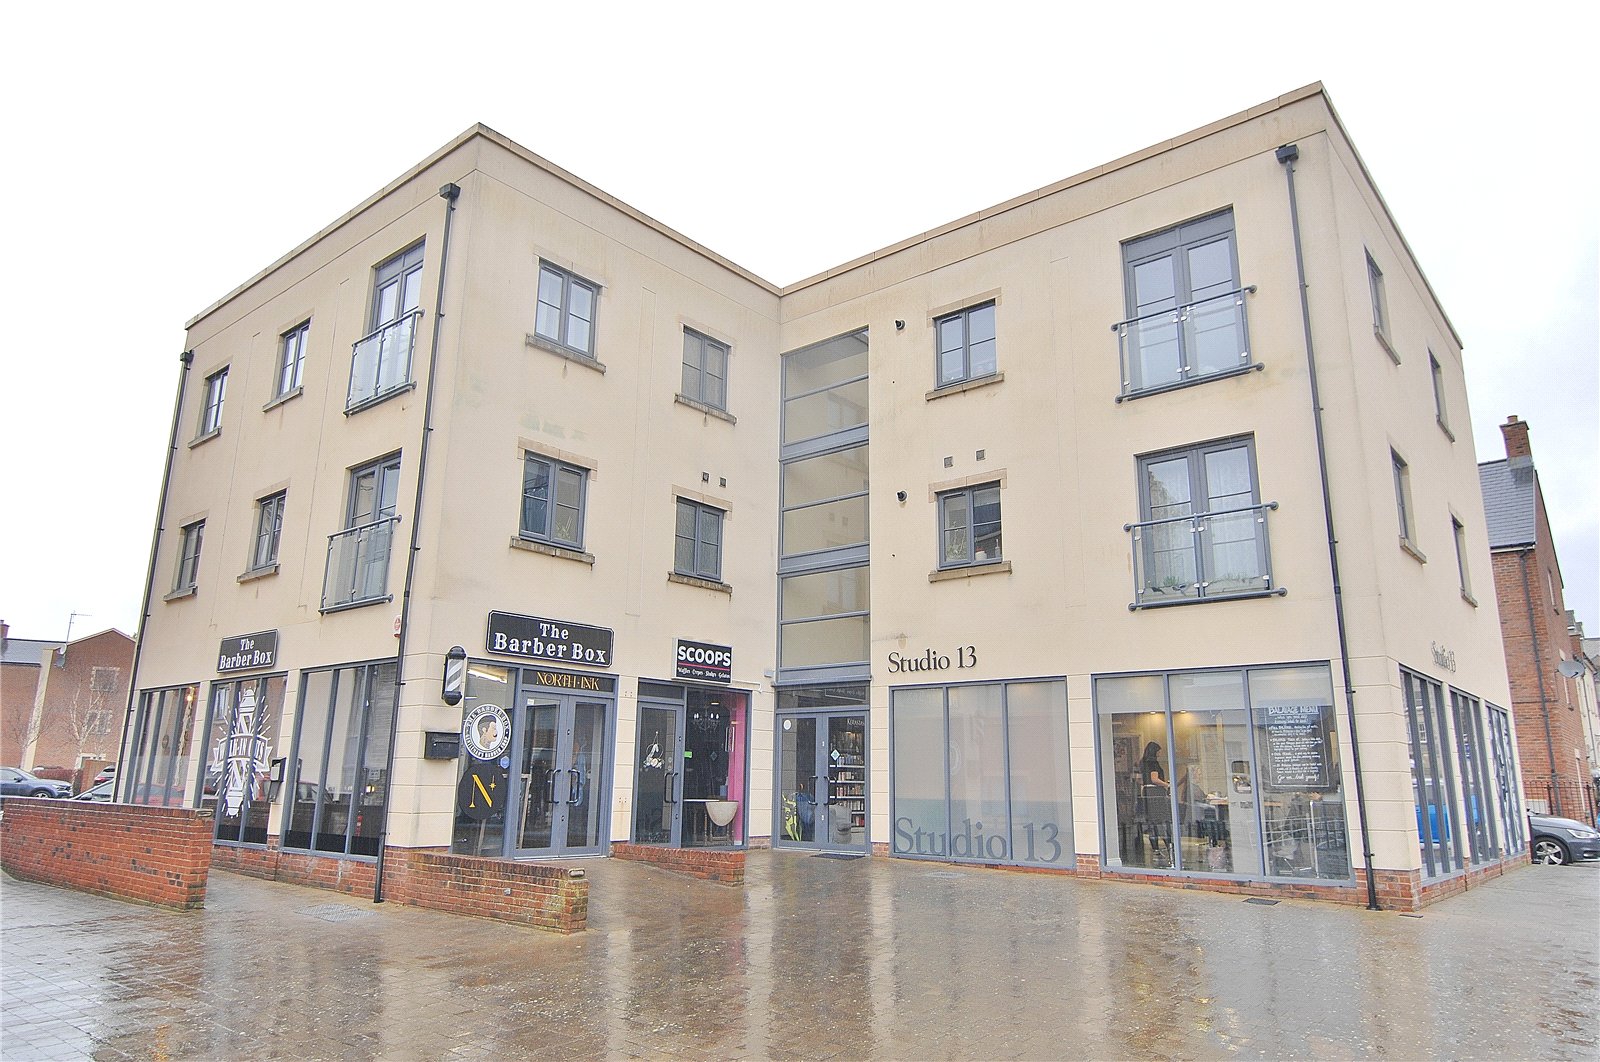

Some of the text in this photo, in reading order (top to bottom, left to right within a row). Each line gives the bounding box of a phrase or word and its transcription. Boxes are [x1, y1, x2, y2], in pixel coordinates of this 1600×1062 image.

[539, 622, 569, 640] The
[240, 638, 255, 651] The
[493, 632, 606, 663] Barber Box
[219, 649, 273, 670] Barber Box
[677, 645, 731, 667] SCOOPS
[887, 645, 978, 674] Studio 13
[895, 816, 1062, 864] Studio 13
